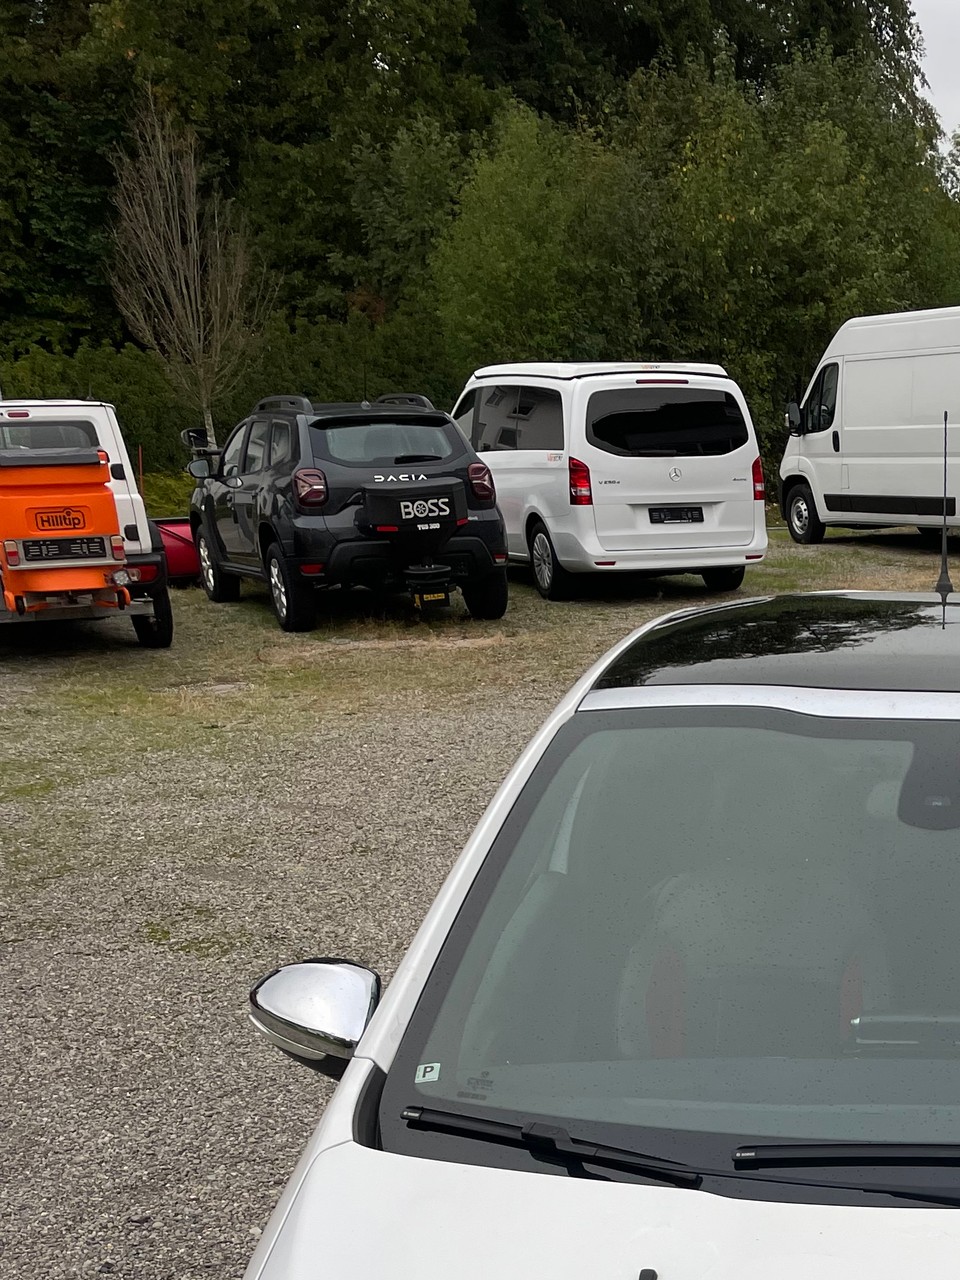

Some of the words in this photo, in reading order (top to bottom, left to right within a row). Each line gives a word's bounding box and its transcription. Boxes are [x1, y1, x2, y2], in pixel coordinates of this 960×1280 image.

[373, 474, 428, 482] DACIA
[400, 498, 451, 519] BOSS
[40, 510, 81, 529] Hilltip
[422, 1065, 434, 1078] P
